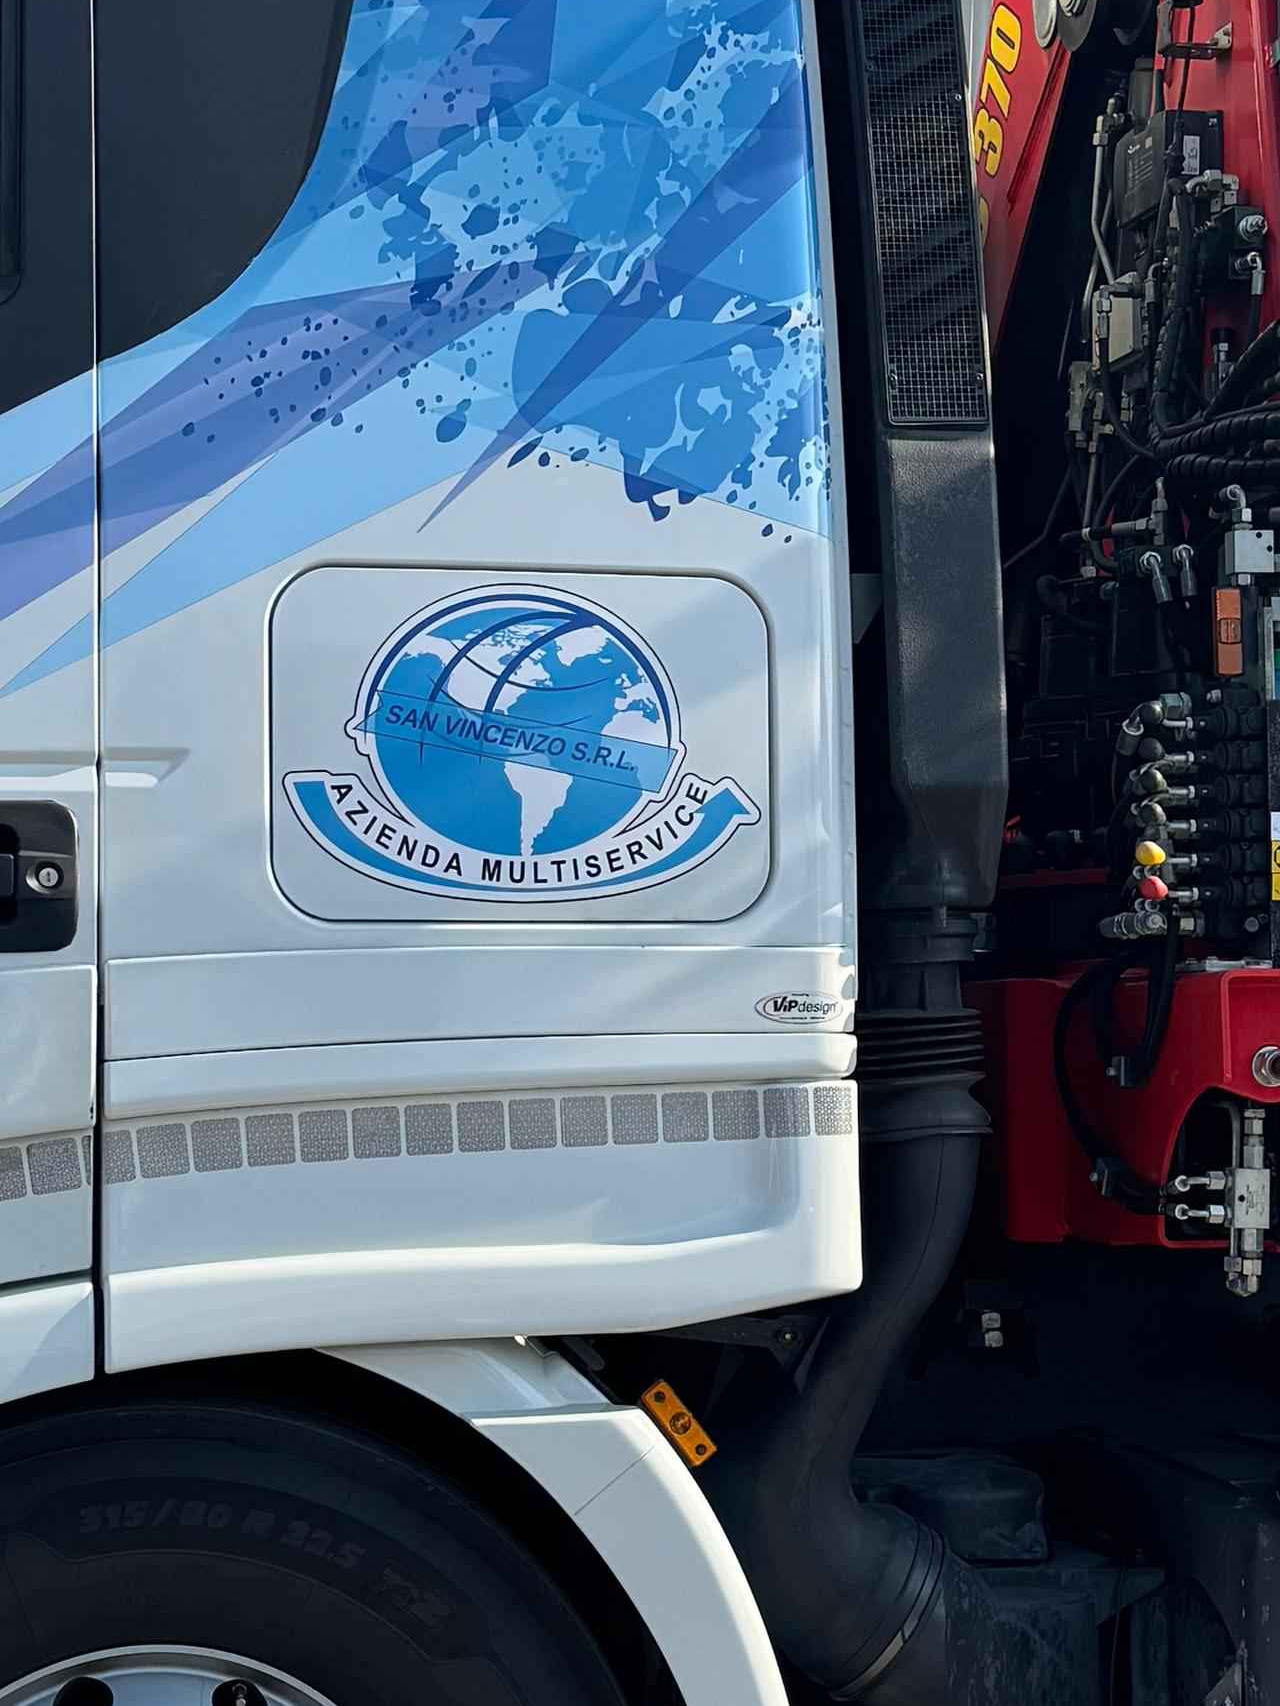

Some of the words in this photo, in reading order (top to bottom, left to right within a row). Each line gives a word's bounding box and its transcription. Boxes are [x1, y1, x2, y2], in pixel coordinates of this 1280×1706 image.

[973, 2, 1022, 178] 370
[385, 703, 441, 732] SAN
[444, 712, 567, 758] VINCENZO
[571, 740, 637, 773] S.R.L.
[330, 782, 465, 878] AZIENDA
[480, 781, 709, 886] MULTISERVICE
[78, 1497, 233, 1535] 315/80
